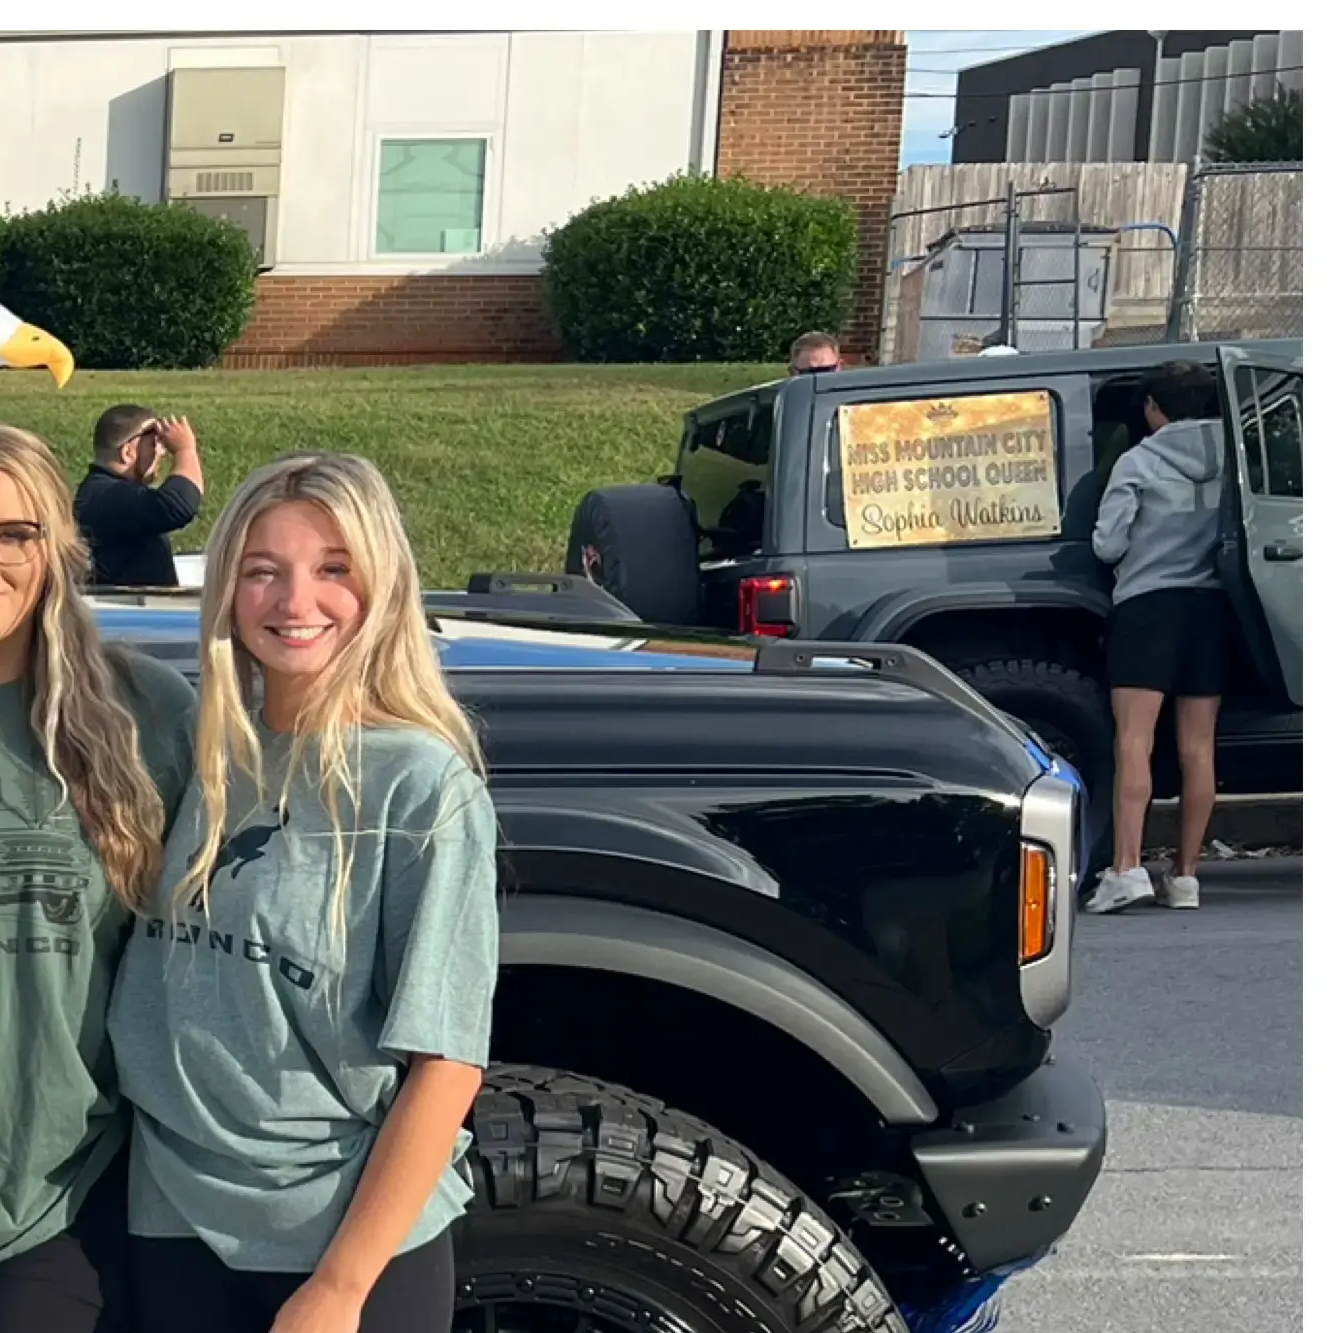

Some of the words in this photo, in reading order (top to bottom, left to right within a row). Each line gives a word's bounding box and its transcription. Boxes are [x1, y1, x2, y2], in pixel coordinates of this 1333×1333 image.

[847, 442, 891, 466] MISS
[895, 433, 997, 462] MOUNTAIN
[1002, 429, 1046, 454] CITY
[852, 469, 899, 495] HIGH
[903, 463, 981, 491] SCHOOL
[985, 459, 1047, 485] QUEEN
[861, 501, 943, 540] Sophia
[950, 494, 1045, 528] Watkins
